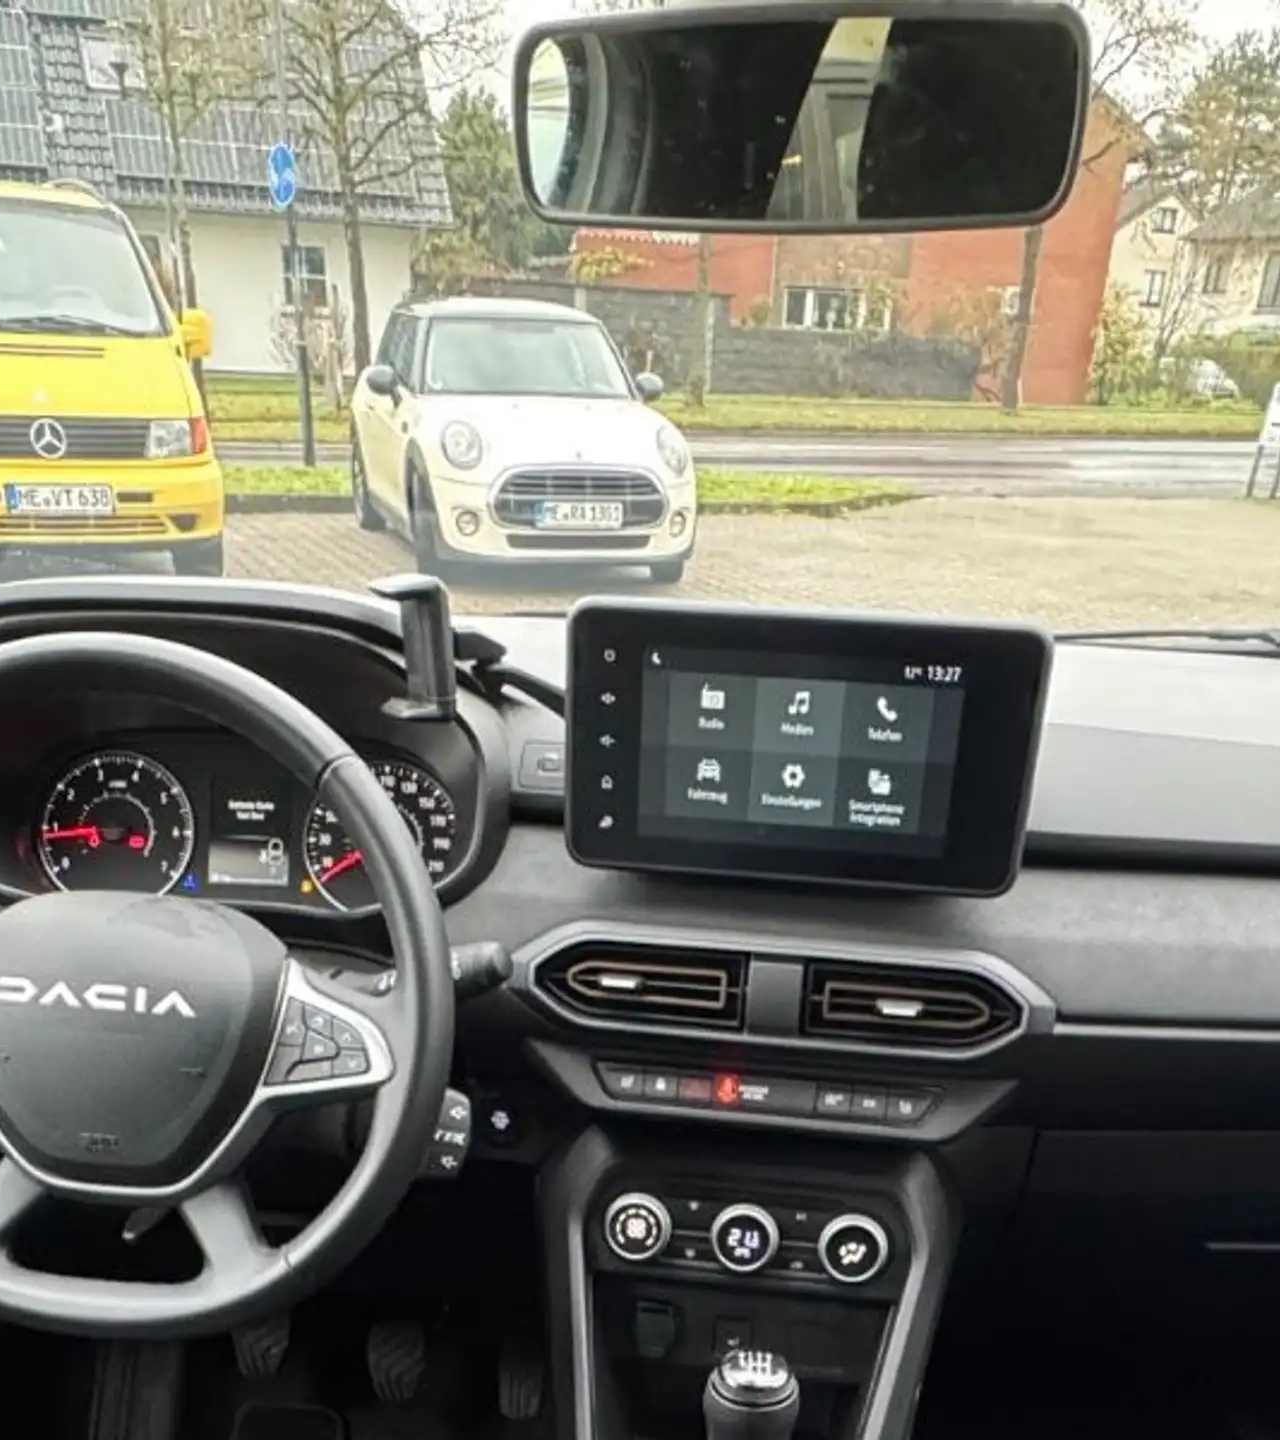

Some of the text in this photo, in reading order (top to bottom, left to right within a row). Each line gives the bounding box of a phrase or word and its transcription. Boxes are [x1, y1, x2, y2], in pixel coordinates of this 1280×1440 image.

[78, 488, 109, 508] 638
[927, 665, 962, 682] 13:27
[868, 726, 903, 742] Telefon
